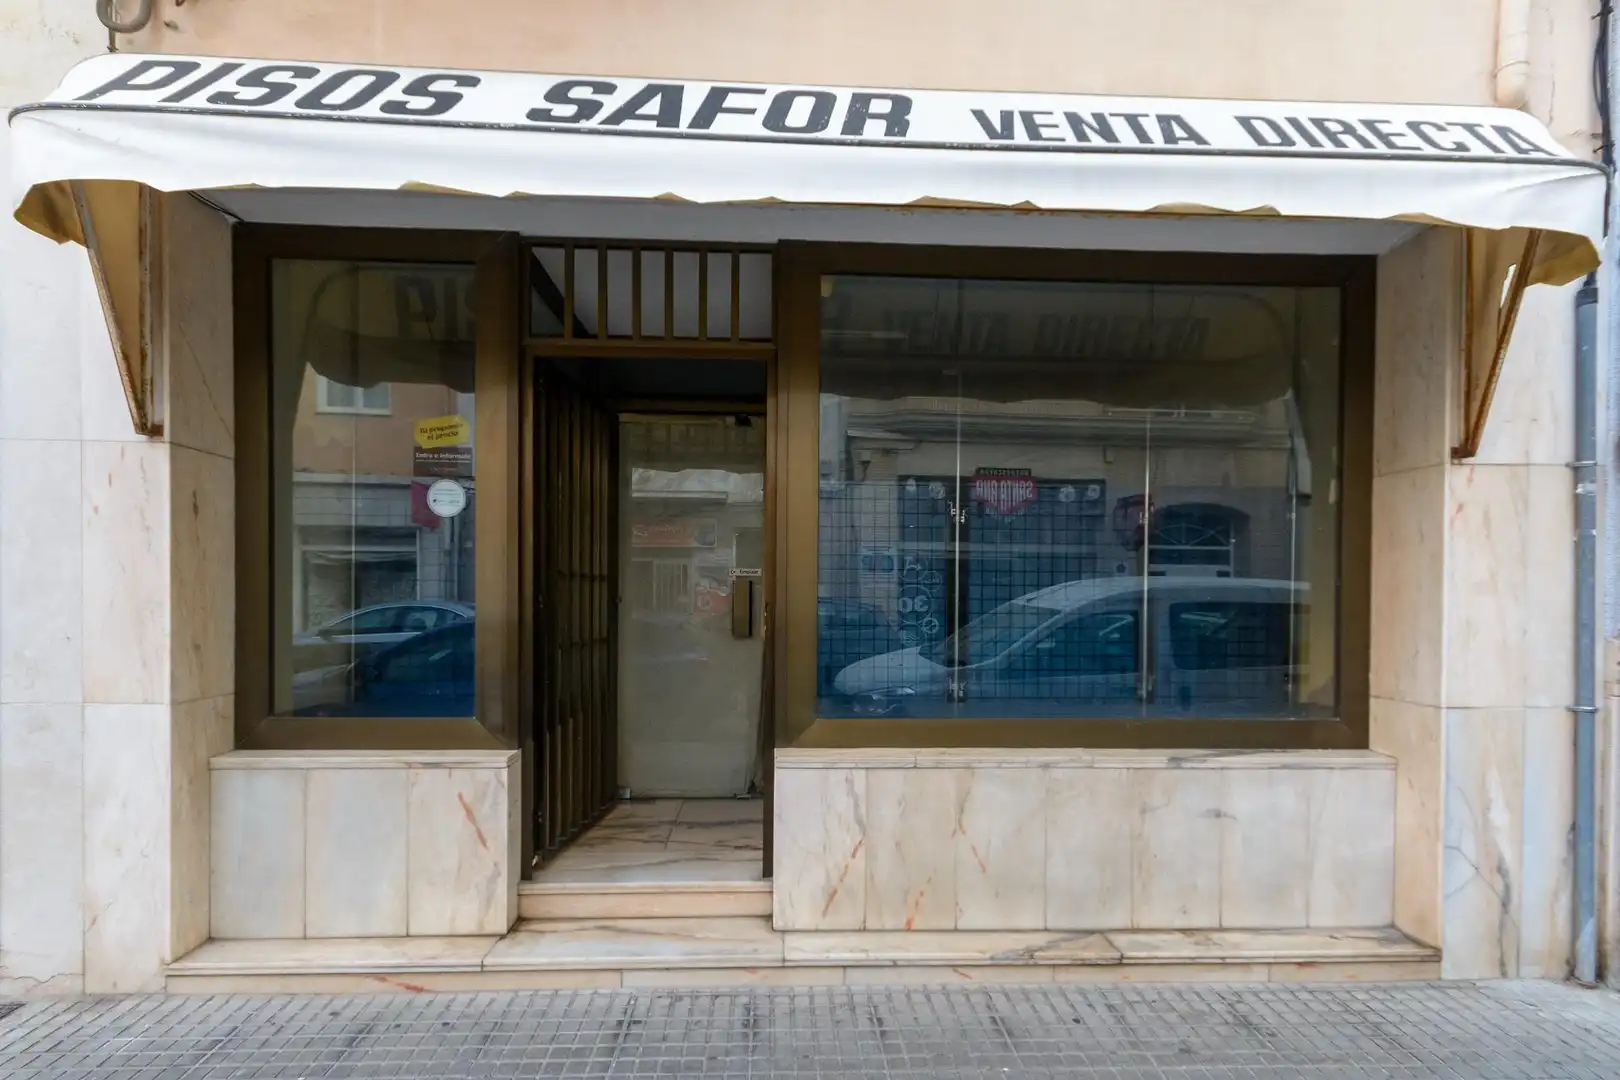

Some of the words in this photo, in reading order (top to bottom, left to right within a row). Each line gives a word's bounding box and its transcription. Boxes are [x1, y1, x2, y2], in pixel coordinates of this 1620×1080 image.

[76, 60, 480, 116] PISOS
[526, 80, 912, 137] SAFOR
[971, 109, 1210, 145] VENTA
[1234, 116, 1557, 156] DIRECTA
